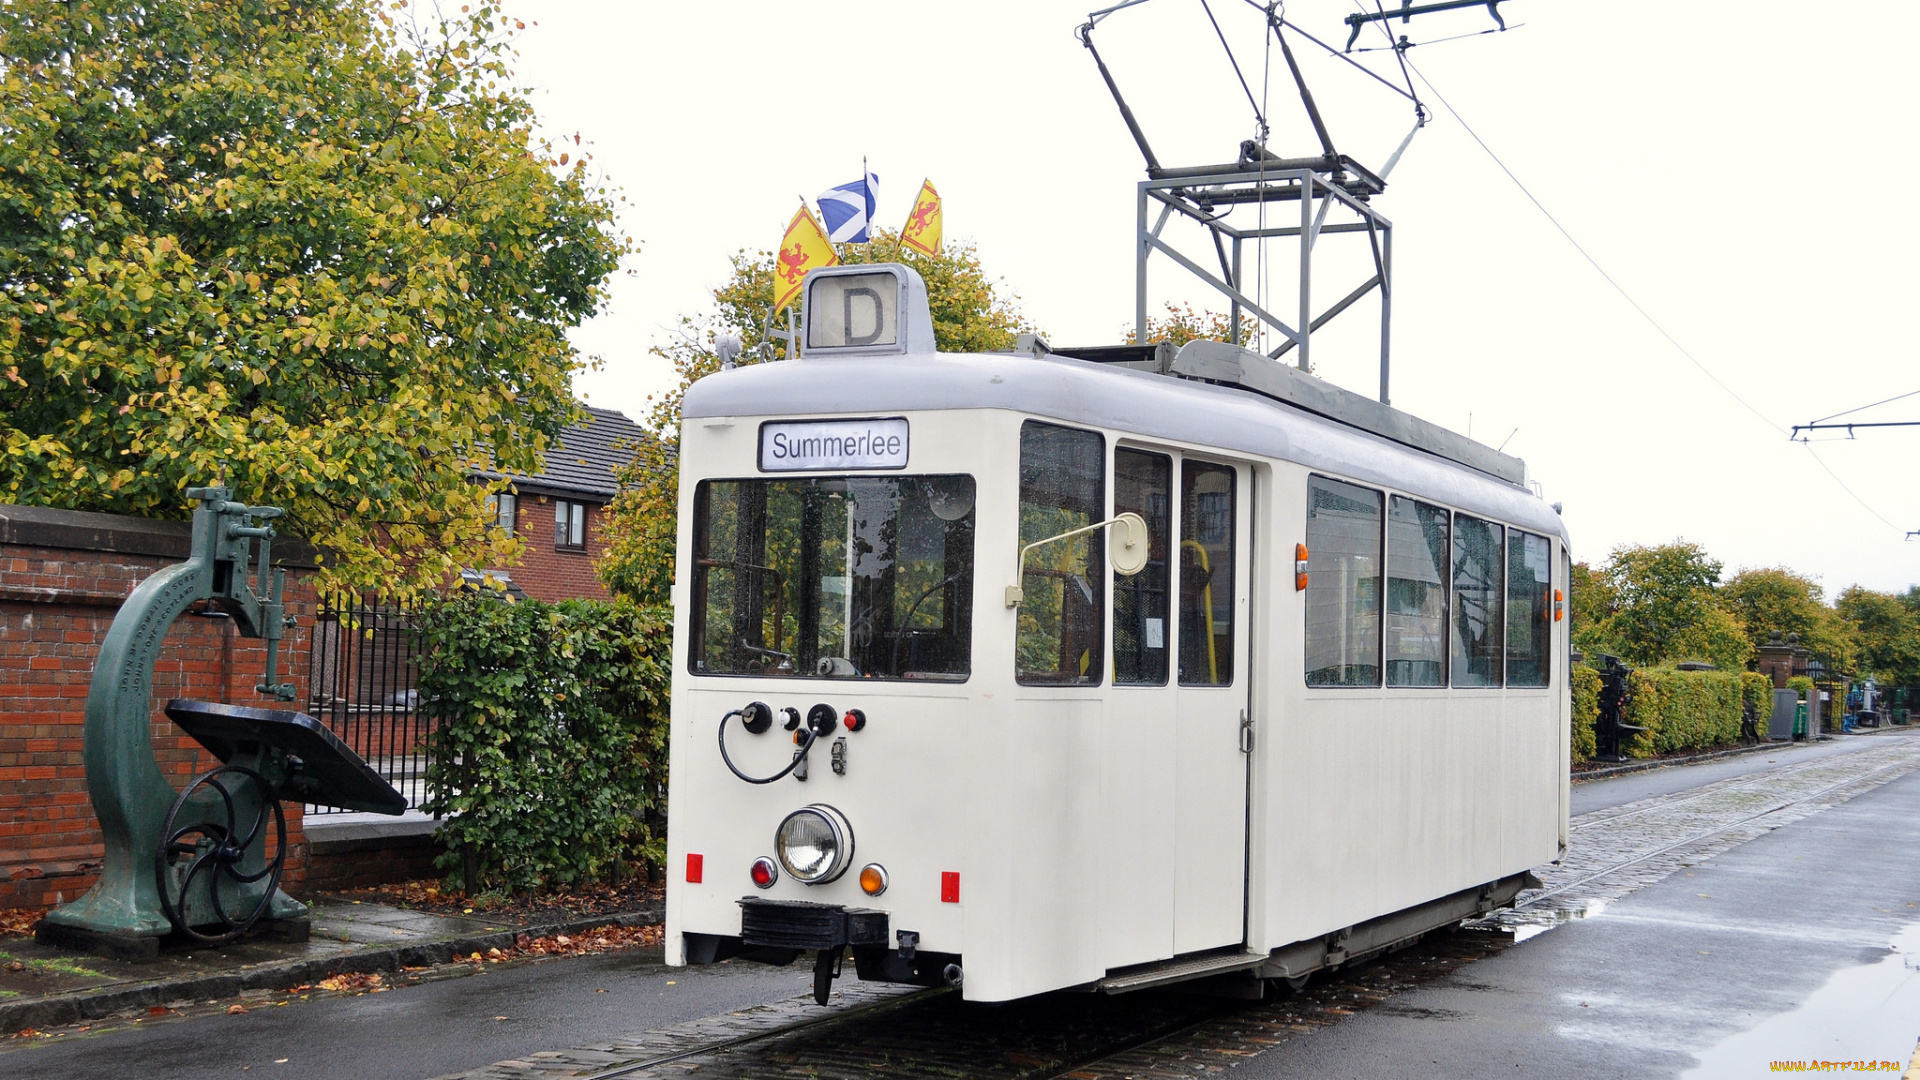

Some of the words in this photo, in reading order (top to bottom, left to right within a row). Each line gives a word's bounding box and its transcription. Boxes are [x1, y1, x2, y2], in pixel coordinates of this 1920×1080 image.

[843, 287, 884, 345] D
[772, 429, 901, 459] Summerlee
[121, 660, 133, 692] JOHN
[136, 599, 164, 639] DOWALL
[172, 572, 195, 590] SONS
[132, 626, 158, 692] JOHNSTONE
[157, 585, 195, 626] SCOTLAND
